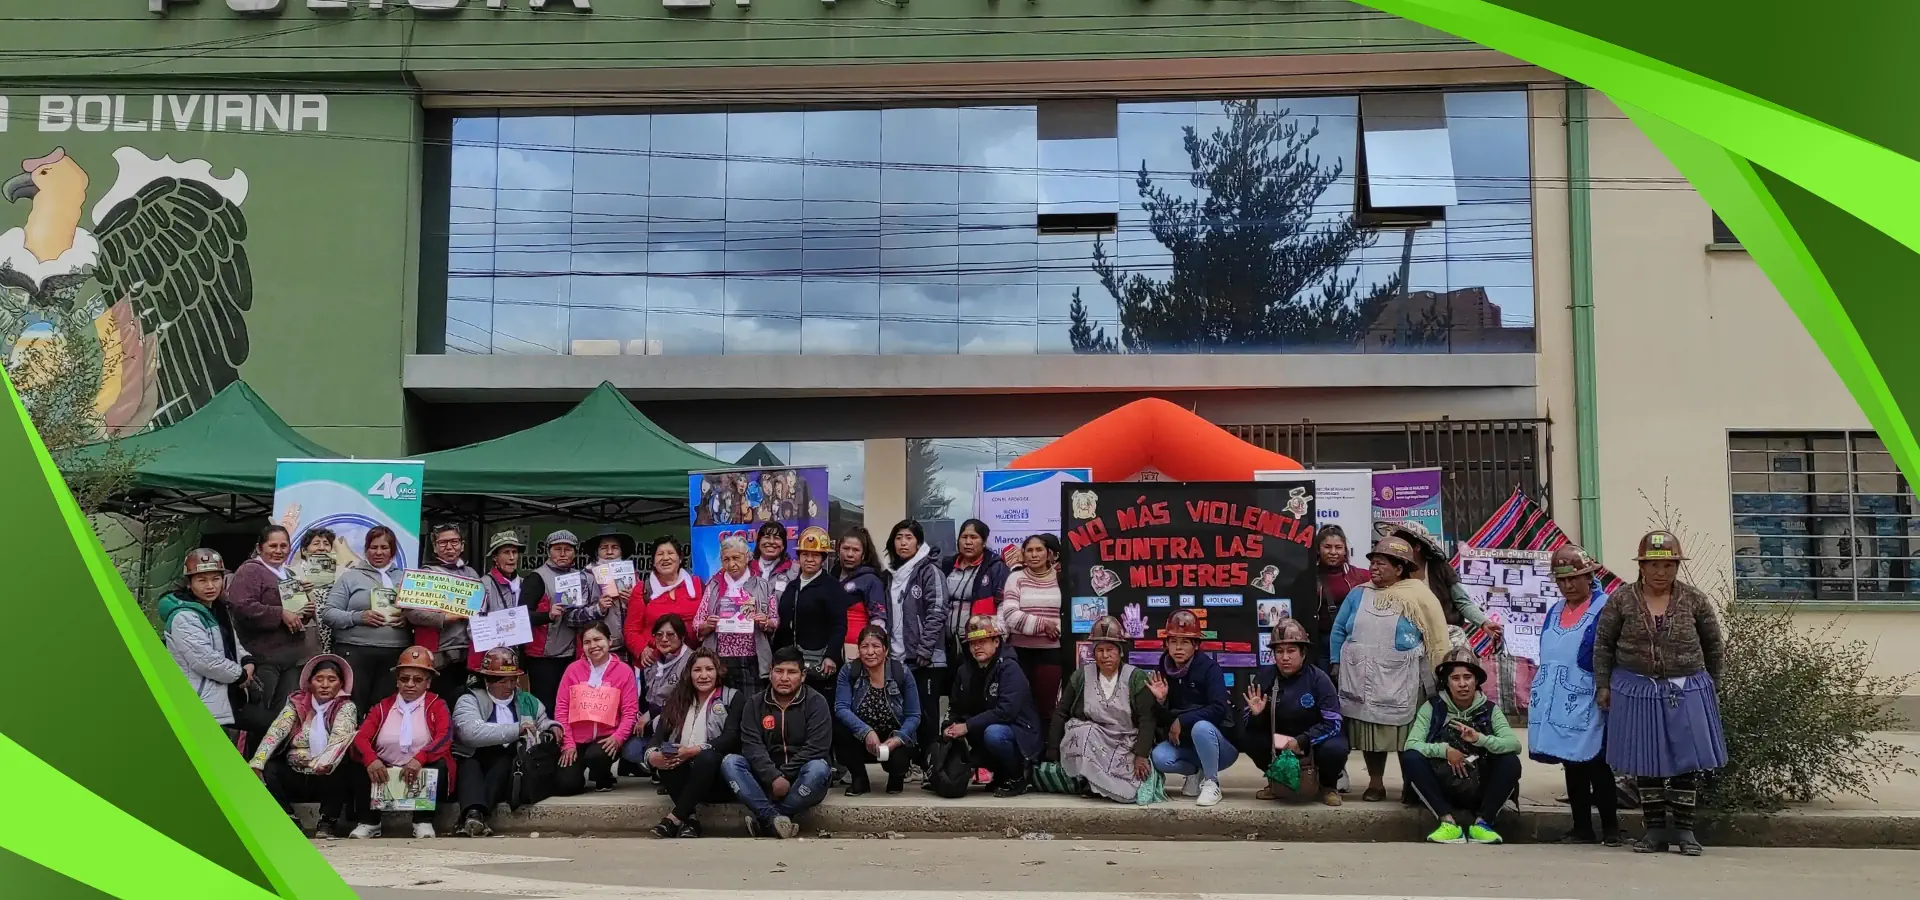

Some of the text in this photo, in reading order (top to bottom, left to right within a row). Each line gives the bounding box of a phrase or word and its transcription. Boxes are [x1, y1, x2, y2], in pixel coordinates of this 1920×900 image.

[38, 94, 328, 132] BOLIVIANA
[1317, 509, 1339, 518] icio
[1382, 507, 1409, 518] ATENCIÓN
[1411, 509, 1419, 517] en
[1067, 495, 1315, 552] NO MÁS VIOLENCIA
[995, 536, 1023, 544] Marcos
[1099, 534, 1264, 562] CONTRA LAS
[1467, 548, 1504, 558] OLENCIA
[1129, 562, 1249, 588] MUJERES
[433, 583, 473, 596] VIOLENCIA
[398, 597, 439, 607] NECESITA
[415, 590, 447, 600] FAMILIA
[455, 597, 467, 606] TE
[579, 702, 609, 712] ABRAZO
